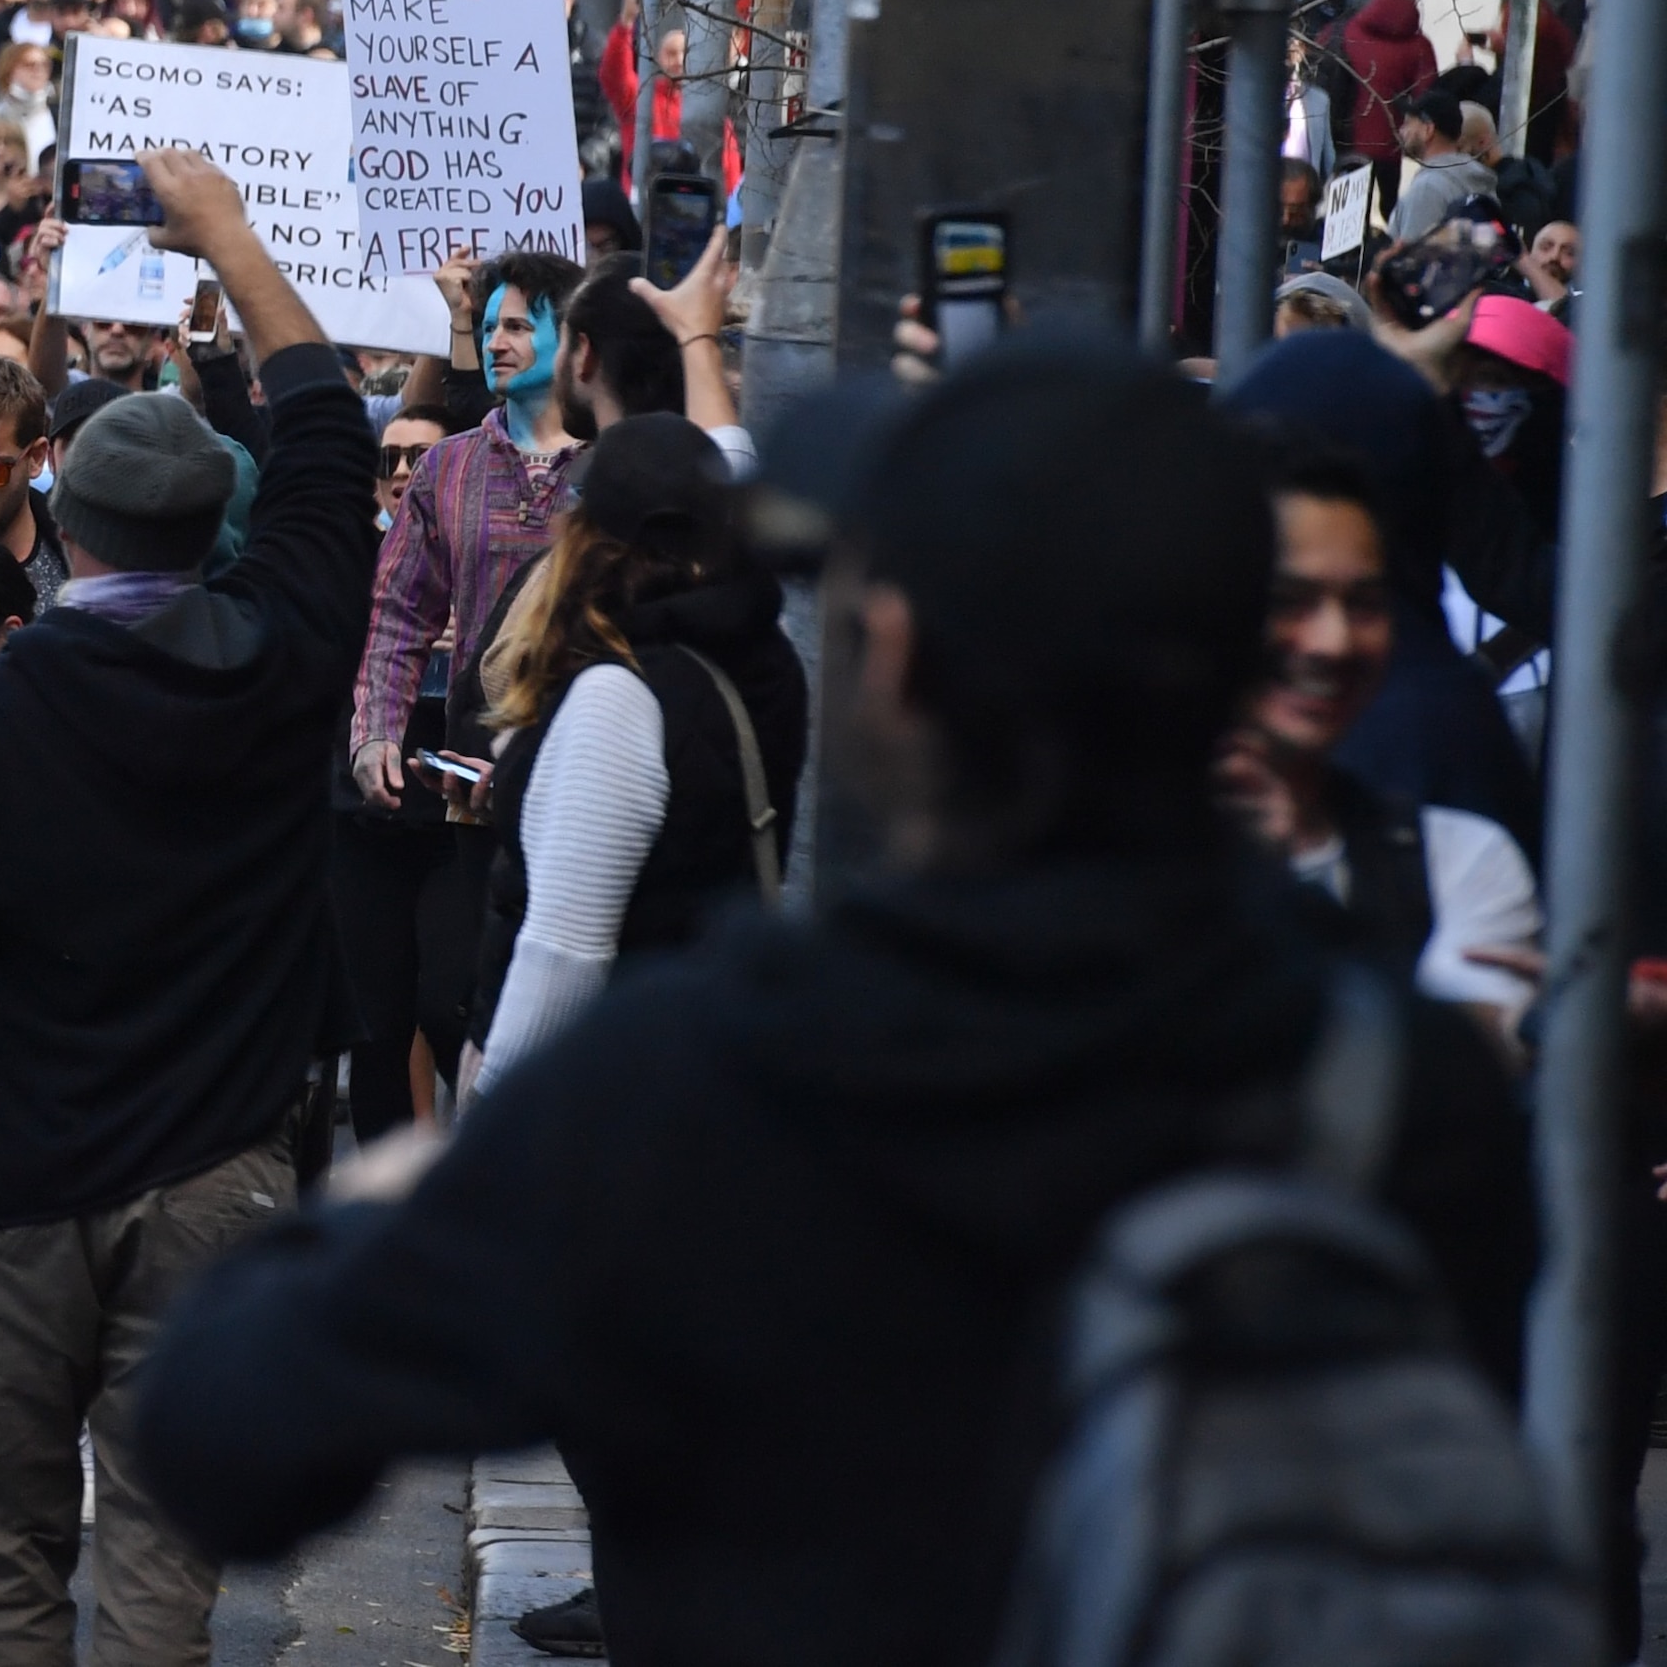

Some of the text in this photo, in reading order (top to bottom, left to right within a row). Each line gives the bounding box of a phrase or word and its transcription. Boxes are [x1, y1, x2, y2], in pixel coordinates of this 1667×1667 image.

[355, 33, 539, 74] YOURSELF A
[216, 71, 303, 97] SAYS:
[353, 74, 479, 106] SLAVE OF
[359, 146, 503, 181] GOD HAS
[243, 181, 341, 211] IBLE”
[365, 182, 563, 216] CREATED YOU
[271, 223, 361, 250] NO T
[364, 223, 579, 273] A FREE MAN!
[274, 260, 388, 293] PRICK!
